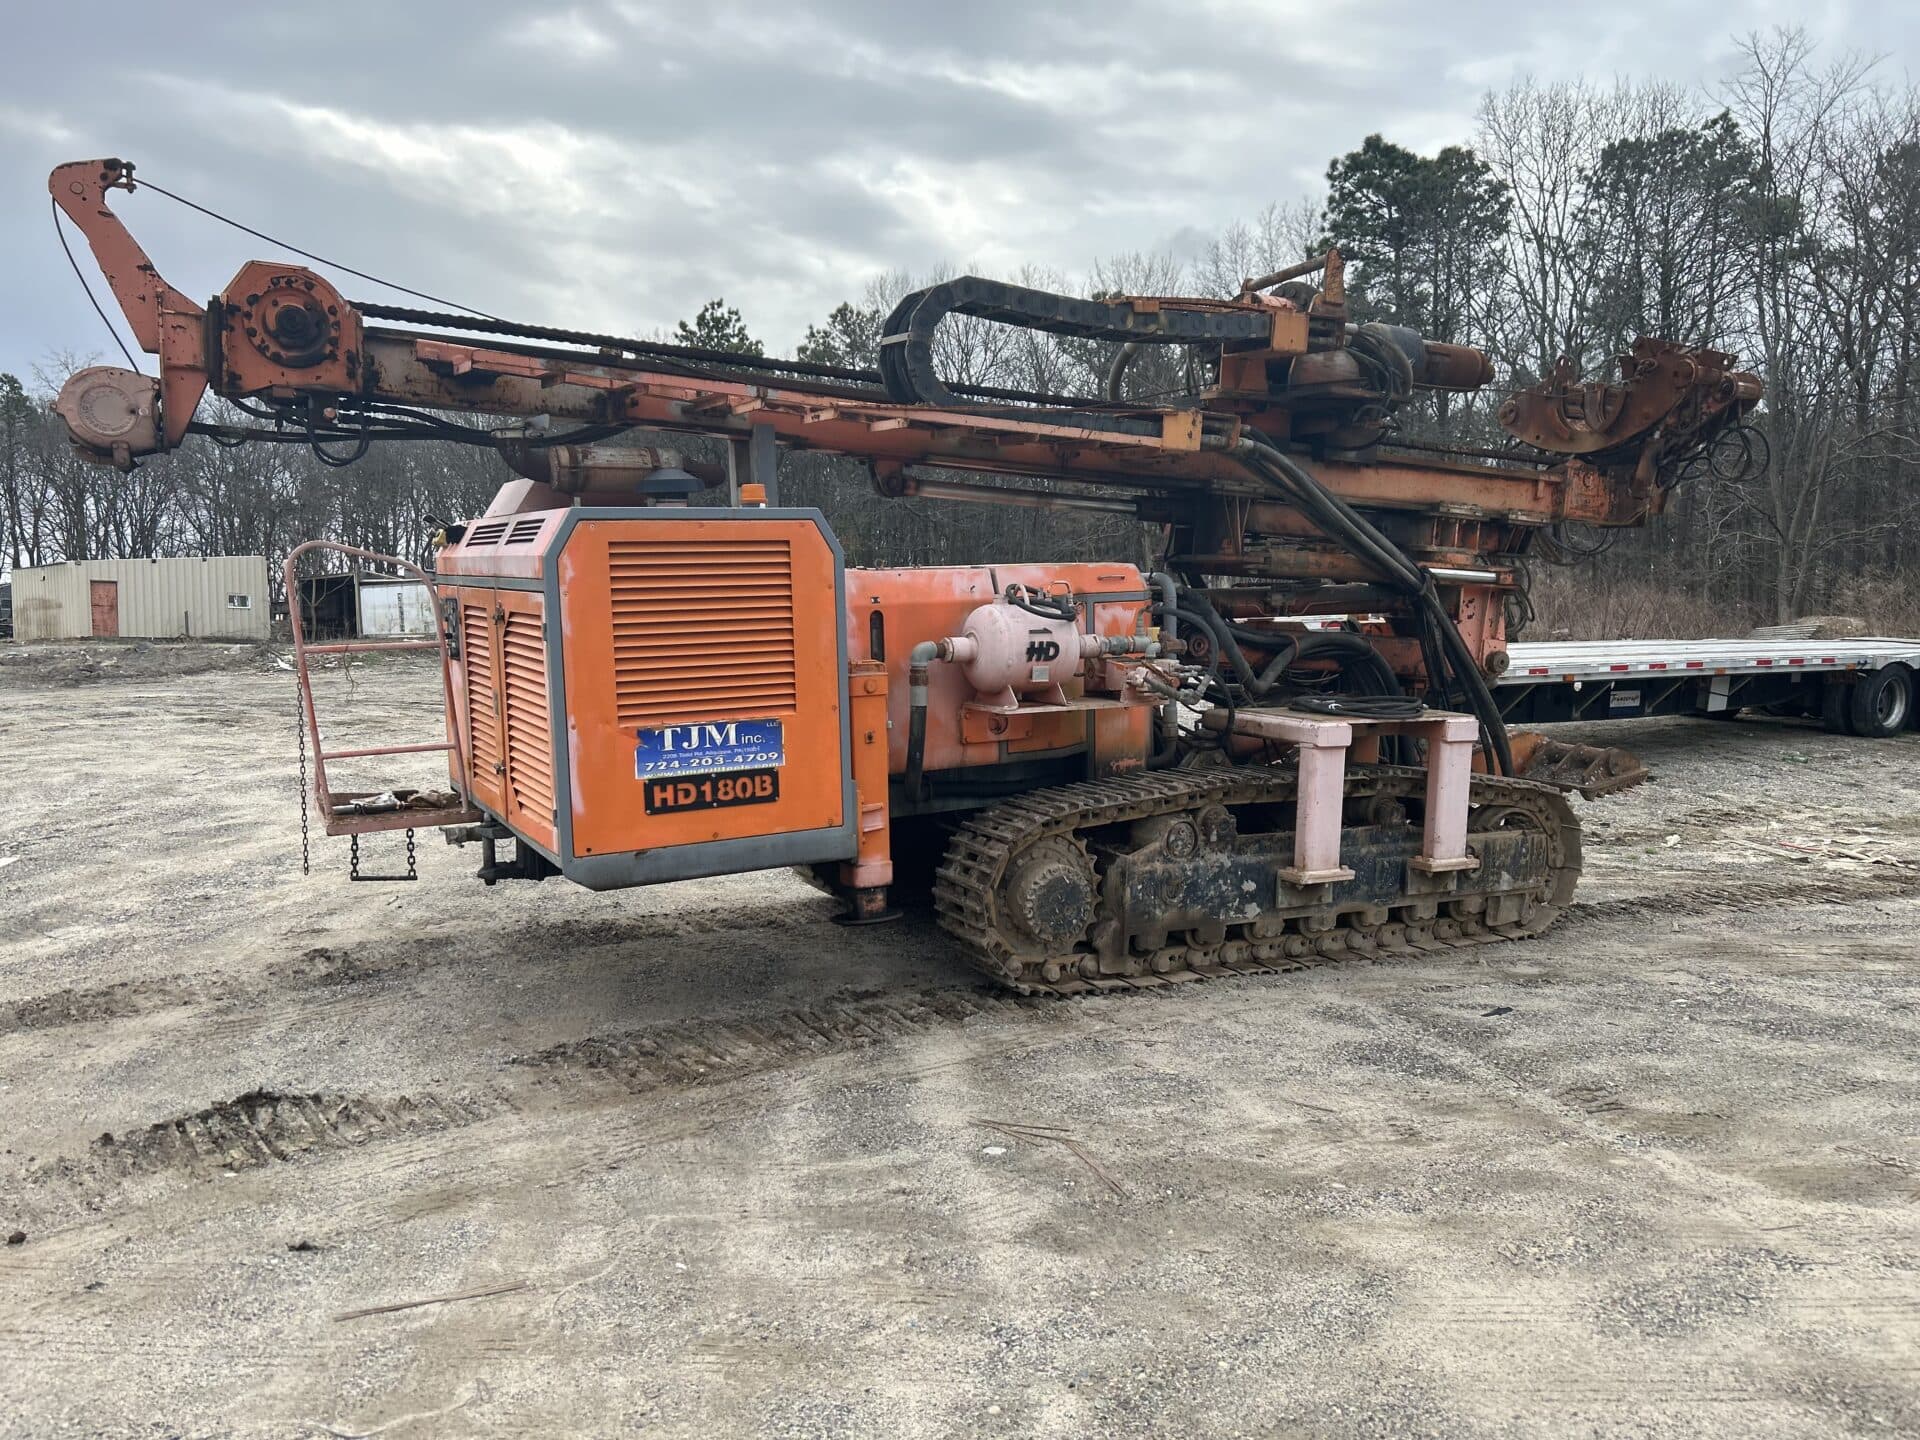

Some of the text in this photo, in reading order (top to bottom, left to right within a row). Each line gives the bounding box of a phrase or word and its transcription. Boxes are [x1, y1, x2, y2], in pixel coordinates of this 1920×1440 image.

[655, 724, 766, 751] TJM inc.
[644, 751, 779, 771] 724-203-4709
[653, 775, 773, 807] HD180B
